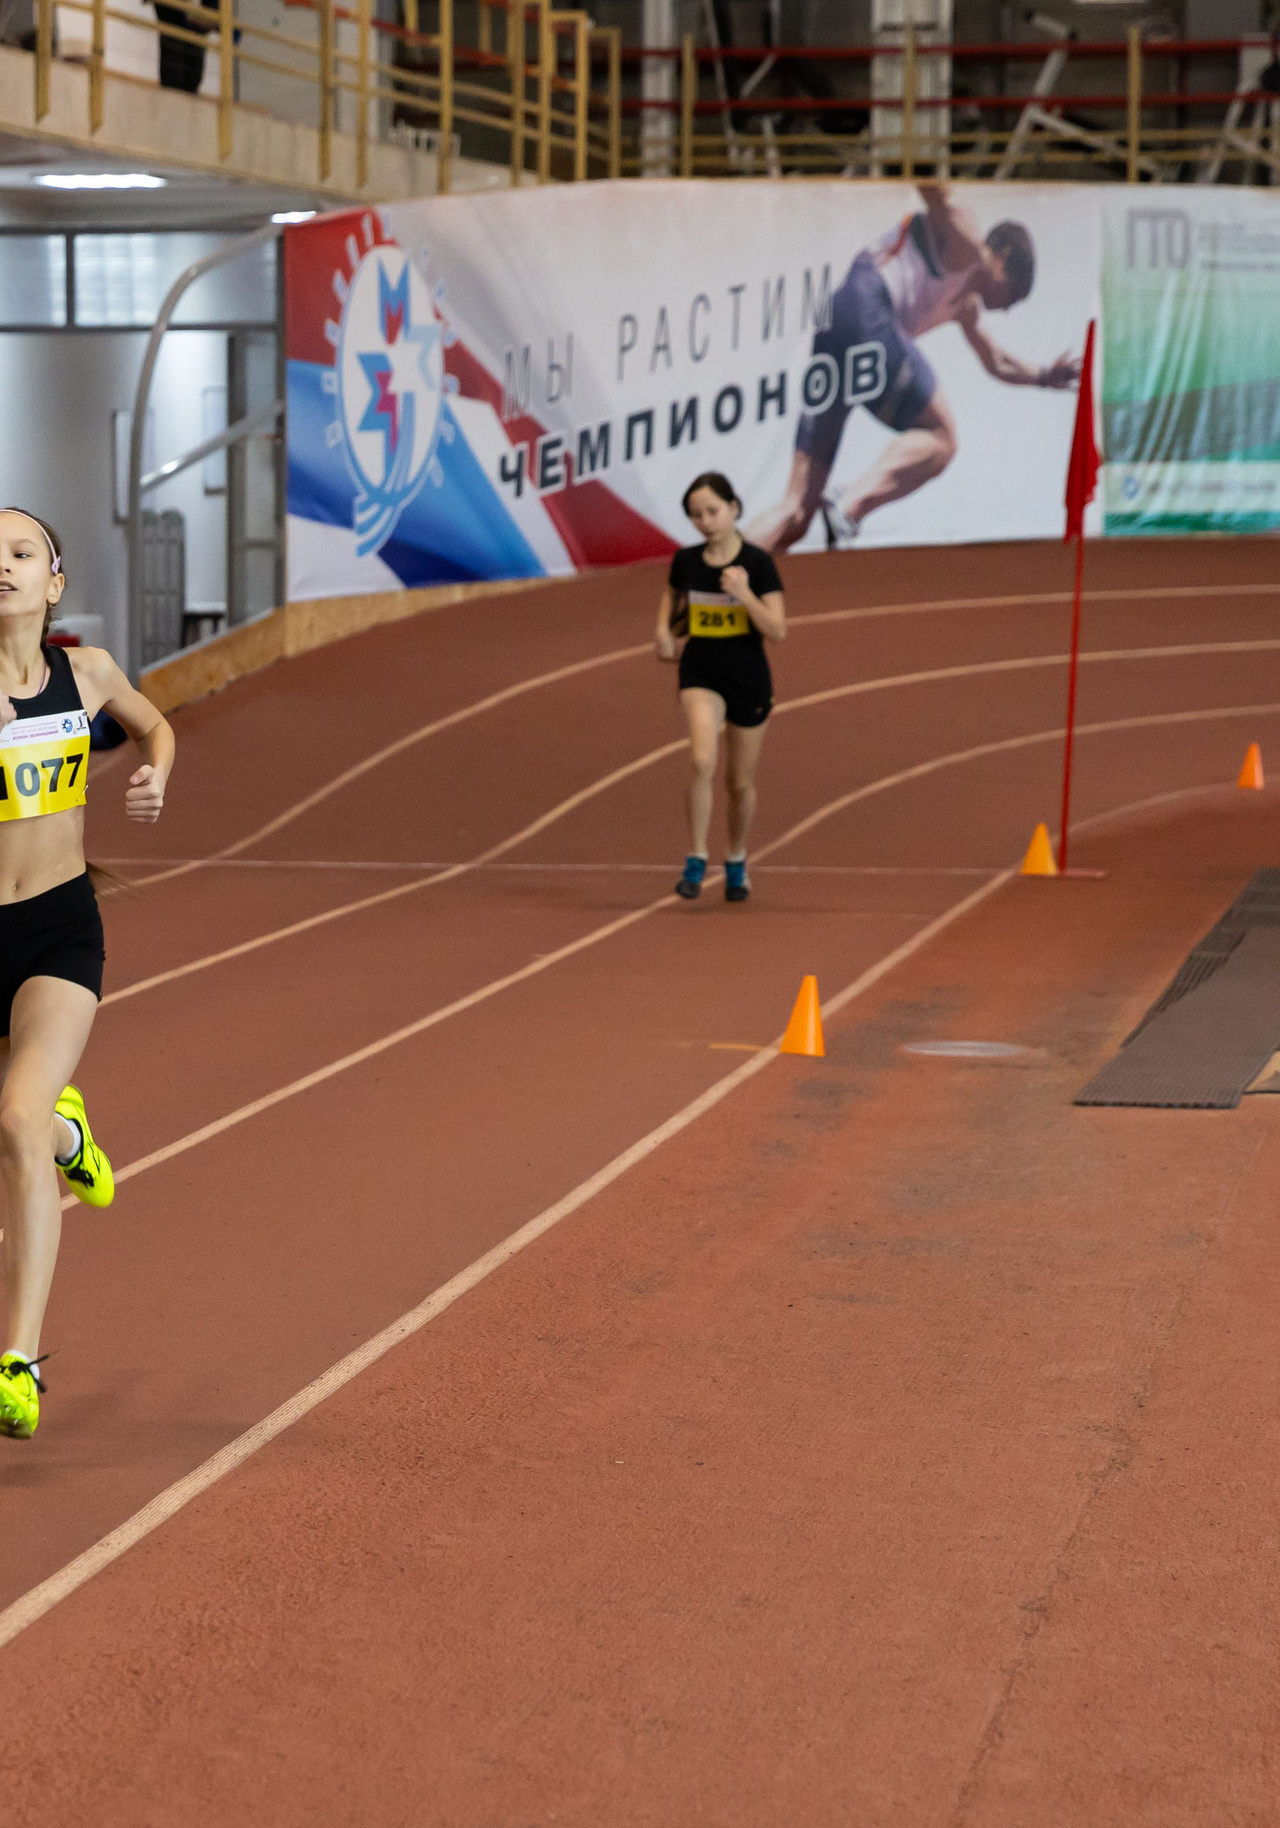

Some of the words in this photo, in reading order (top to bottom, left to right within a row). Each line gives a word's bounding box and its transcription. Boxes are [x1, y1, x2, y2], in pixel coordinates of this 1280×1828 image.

[502, 331, 575, 421] МЫ
[617, 262, 834, 383] РАСТИМ
[498, 342, 886, 498] ЧЕМПИОНОВ
[699, 610, 736, 627] 281
